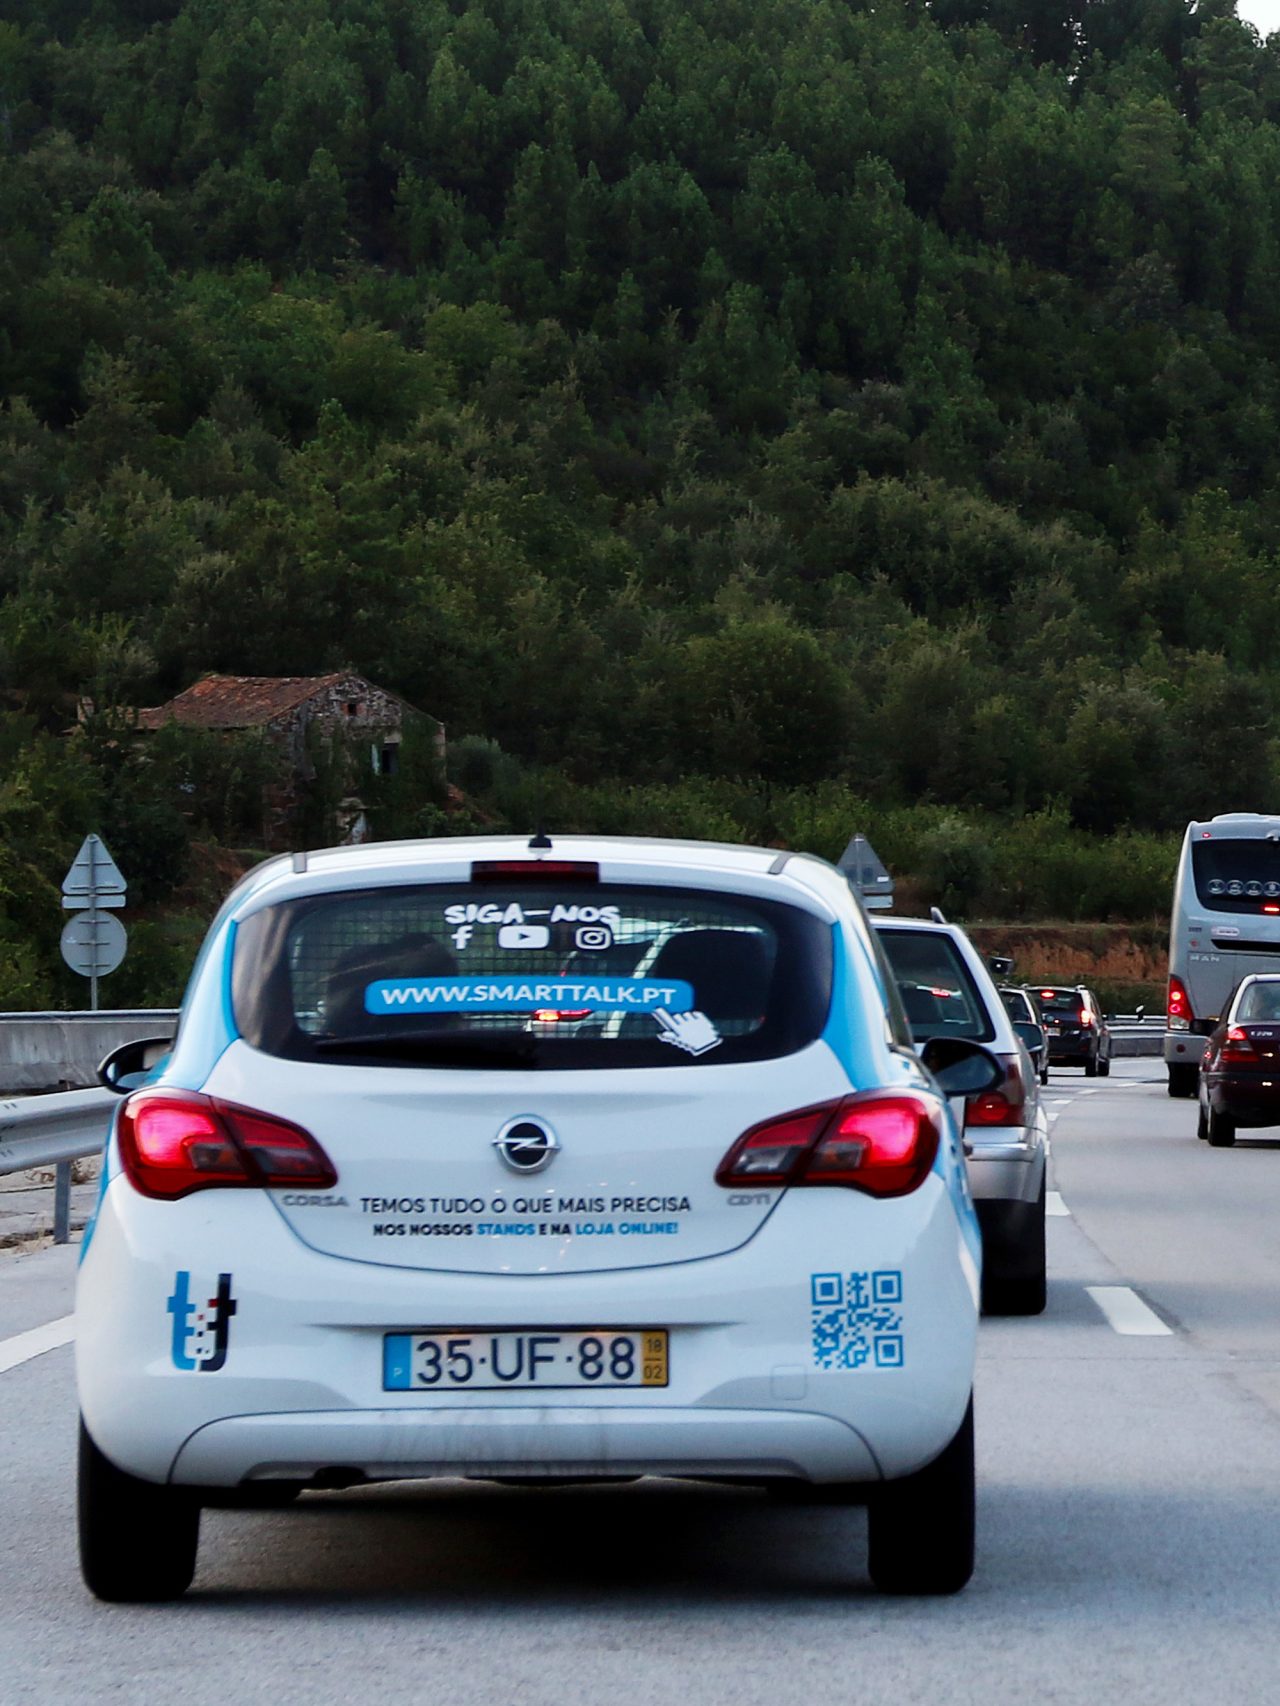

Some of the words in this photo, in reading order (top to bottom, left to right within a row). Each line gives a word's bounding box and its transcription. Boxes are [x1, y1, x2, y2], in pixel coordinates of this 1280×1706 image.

[444, 903, 621, 924] SIGA-NOS
[381, 984, 678, 1006] WWW.SMARTTALK.PT
[282, 1194, 349, 1207] CORSA
[360, 1197, 424, 1214] TEMOS
[430, 1197, 485, 1214] TUDO
[491, 1197, 507, 1213] O
[513, 1197, 552, 1214] QUE
[558, 1197, 605, 1213] MAIS
[610, 1196, 692, 1213] PRECISA
[373, 1223, 405, 1236] NOS
[409, 1223, 473, 1236] NOSSOS
[477, 1223, 535, 1236] STANDS
[538, 1223, 547, 1236] E
[550, 1223, 571, 1236] NA
[575, 1223, 614, 1236] LOJA
[618, 1222, 679, 1235] ONLINE!
[643, 1365, 662, 1379] 02
